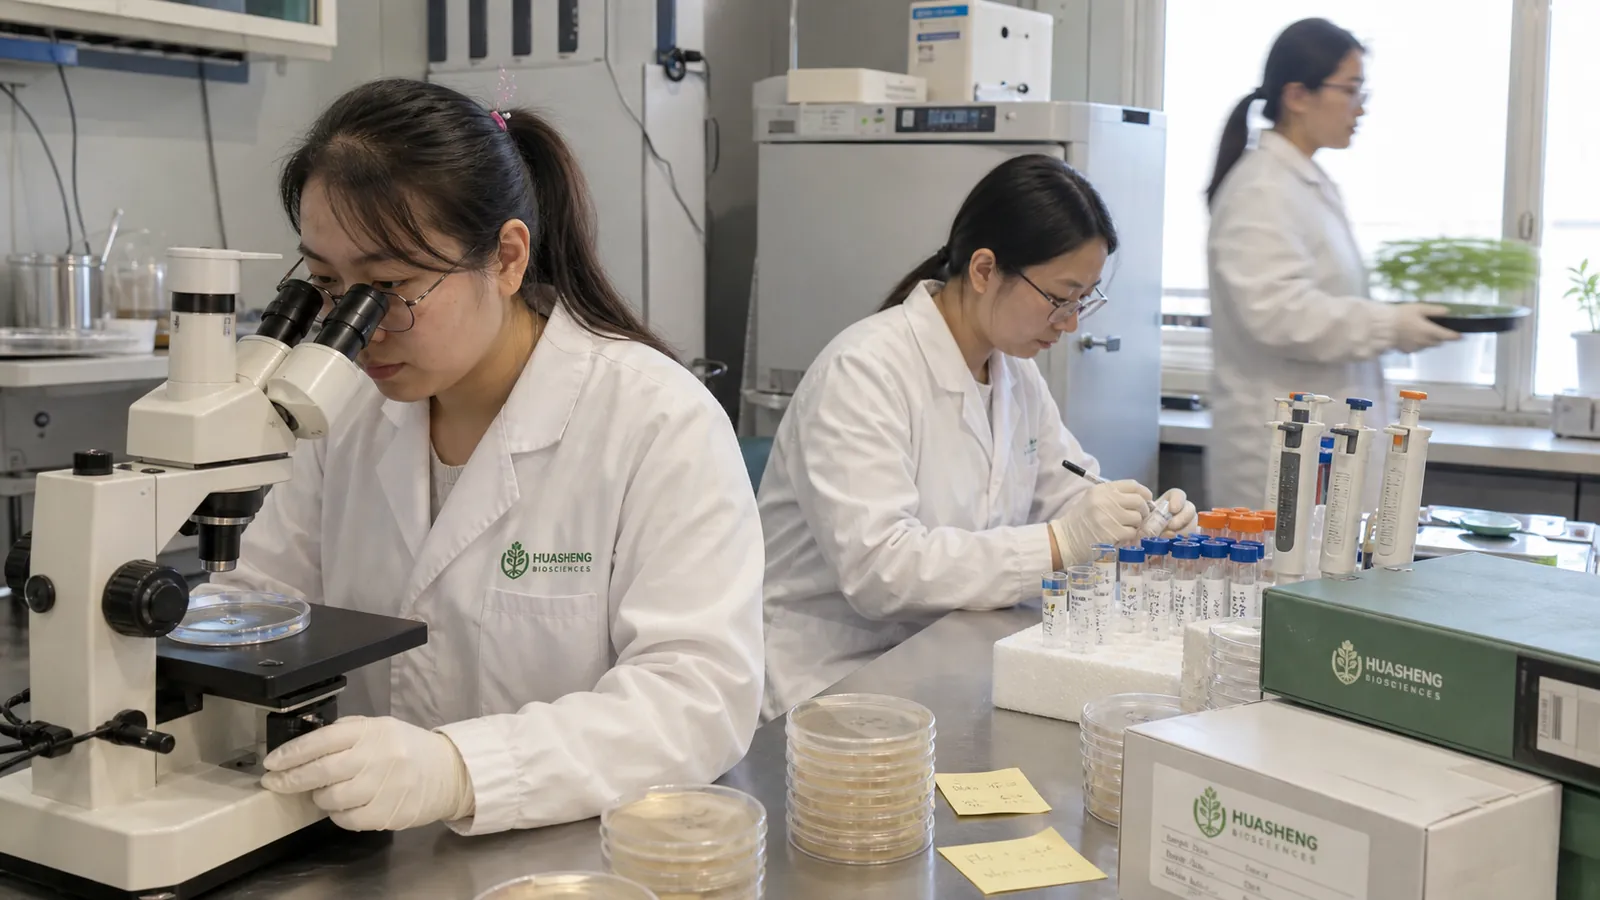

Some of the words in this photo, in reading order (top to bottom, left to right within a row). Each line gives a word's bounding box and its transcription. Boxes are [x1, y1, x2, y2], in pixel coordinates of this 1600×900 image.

[532, 552, 592, 563] HUASHENG
[1366, 656, 1443, 688] HUASHENG
[1365, 674, 1441, 701] BIOSCIENCES
[1232, 809, 1318, 851] HUASHENG
